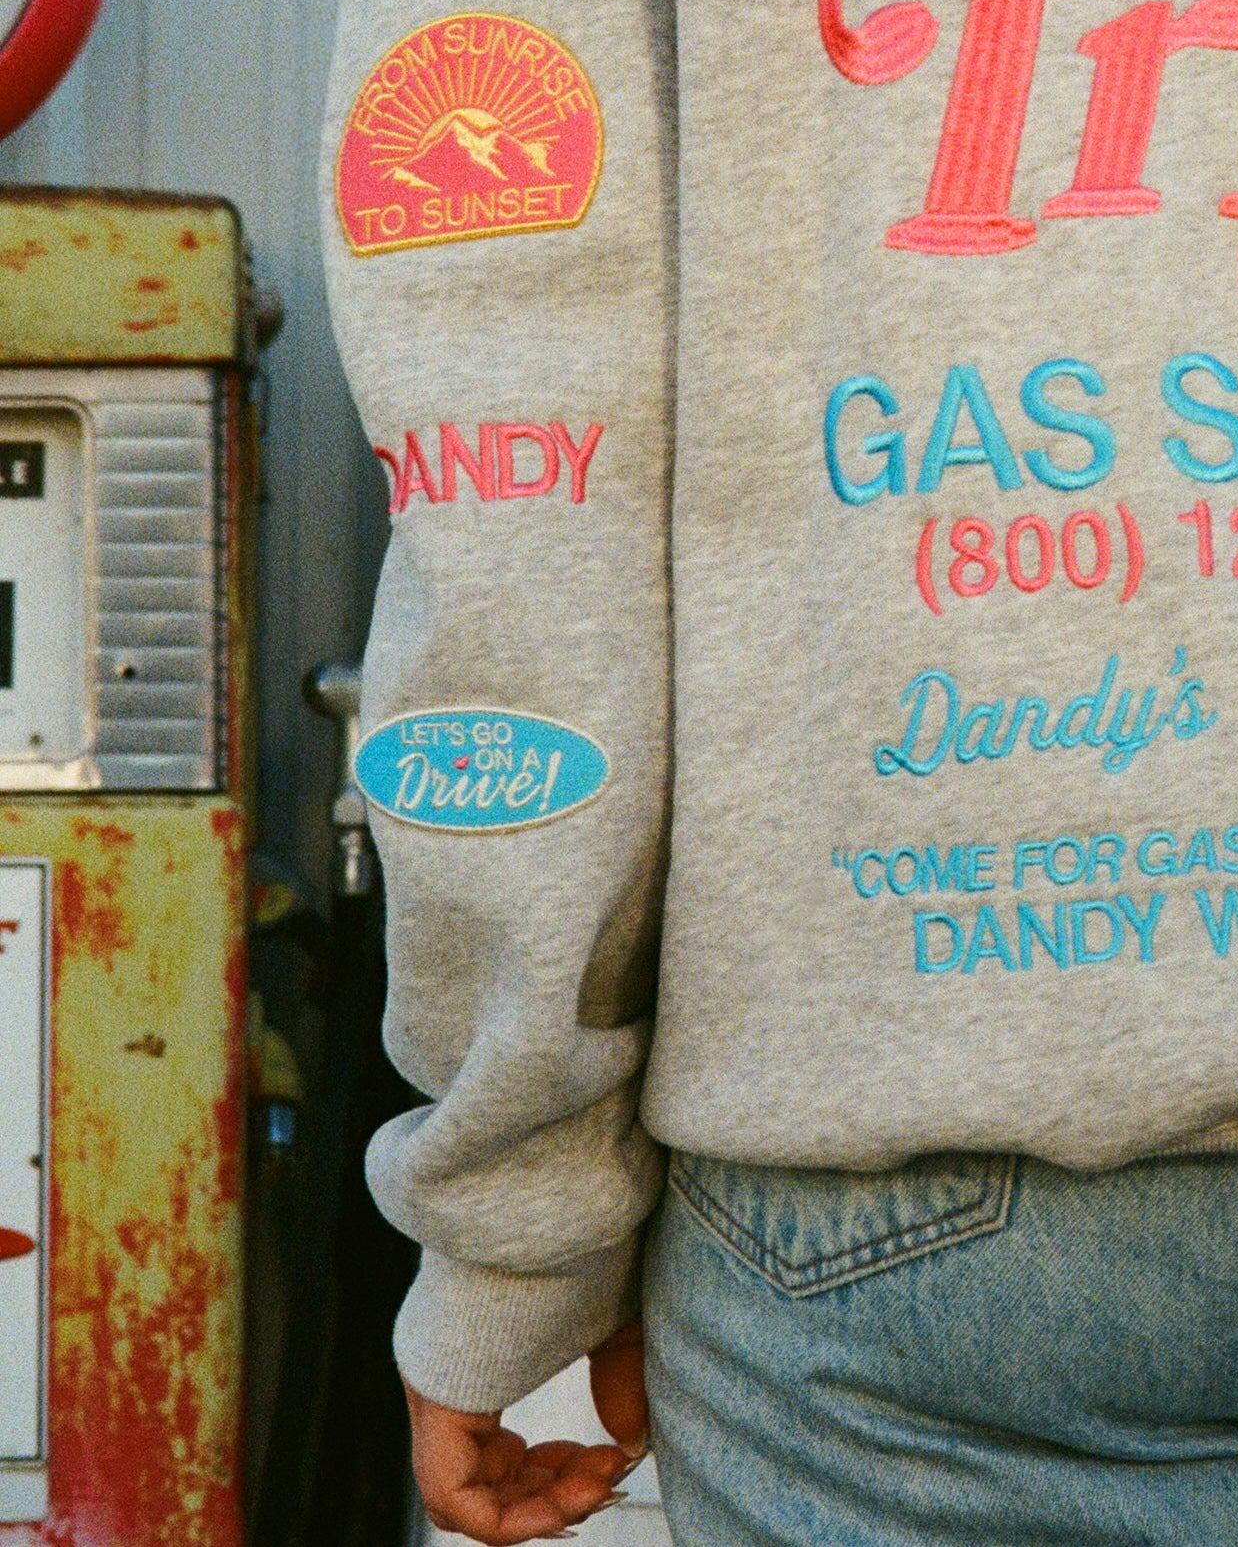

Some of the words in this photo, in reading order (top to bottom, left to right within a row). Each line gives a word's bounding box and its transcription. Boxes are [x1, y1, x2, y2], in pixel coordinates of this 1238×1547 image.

[351, 33, 438, 137] FROM
[443, 22, 589, 124] SUNRISE
[356, 204, 406, 240] TO
[421, 183, 573, 231] SUNSET
[823, 358, 1118, 507] GAS
[915, 501, 1145, 616] (800)
[401, 721, 468, 747] LET'S
[471, 721, 513, 746] GO
[873, 647, 1220, 777] Dandy's
[393, 750, 563, 813] Drive!
[475, 748, 513, 772] ON
[522, 747, 542, 772] A
[831, 843, 1000, 900] "COME
[1012, 834, 1125, 890] FOR
[913, 892, 1167, 976] DANDY
